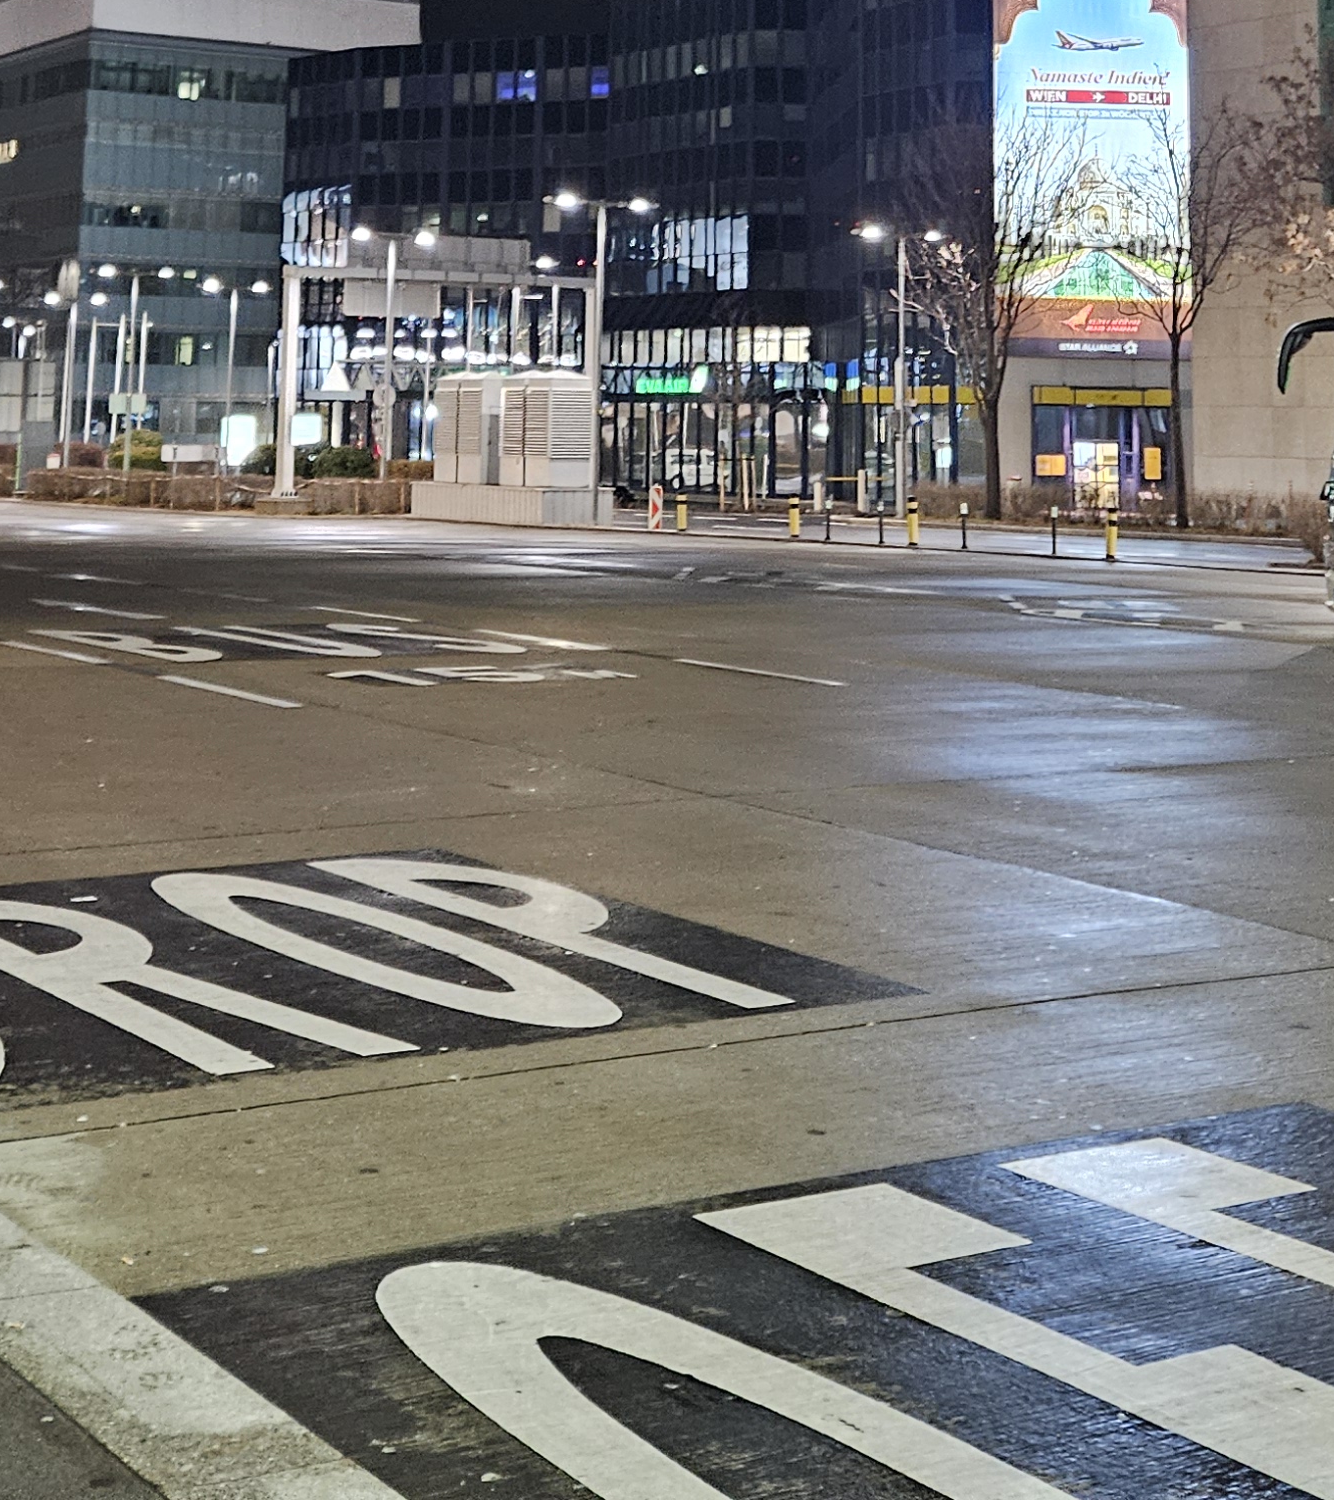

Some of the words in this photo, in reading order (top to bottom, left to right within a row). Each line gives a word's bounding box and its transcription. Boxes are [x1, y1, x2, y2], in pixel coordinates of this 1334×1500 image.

[1027, 67, 1103, 84] Namaste
[1028, 89, 1067, 102] WIEN
[1127, 91, 1168, 104] DELHI
[27, 622, 528, 663] BUS
